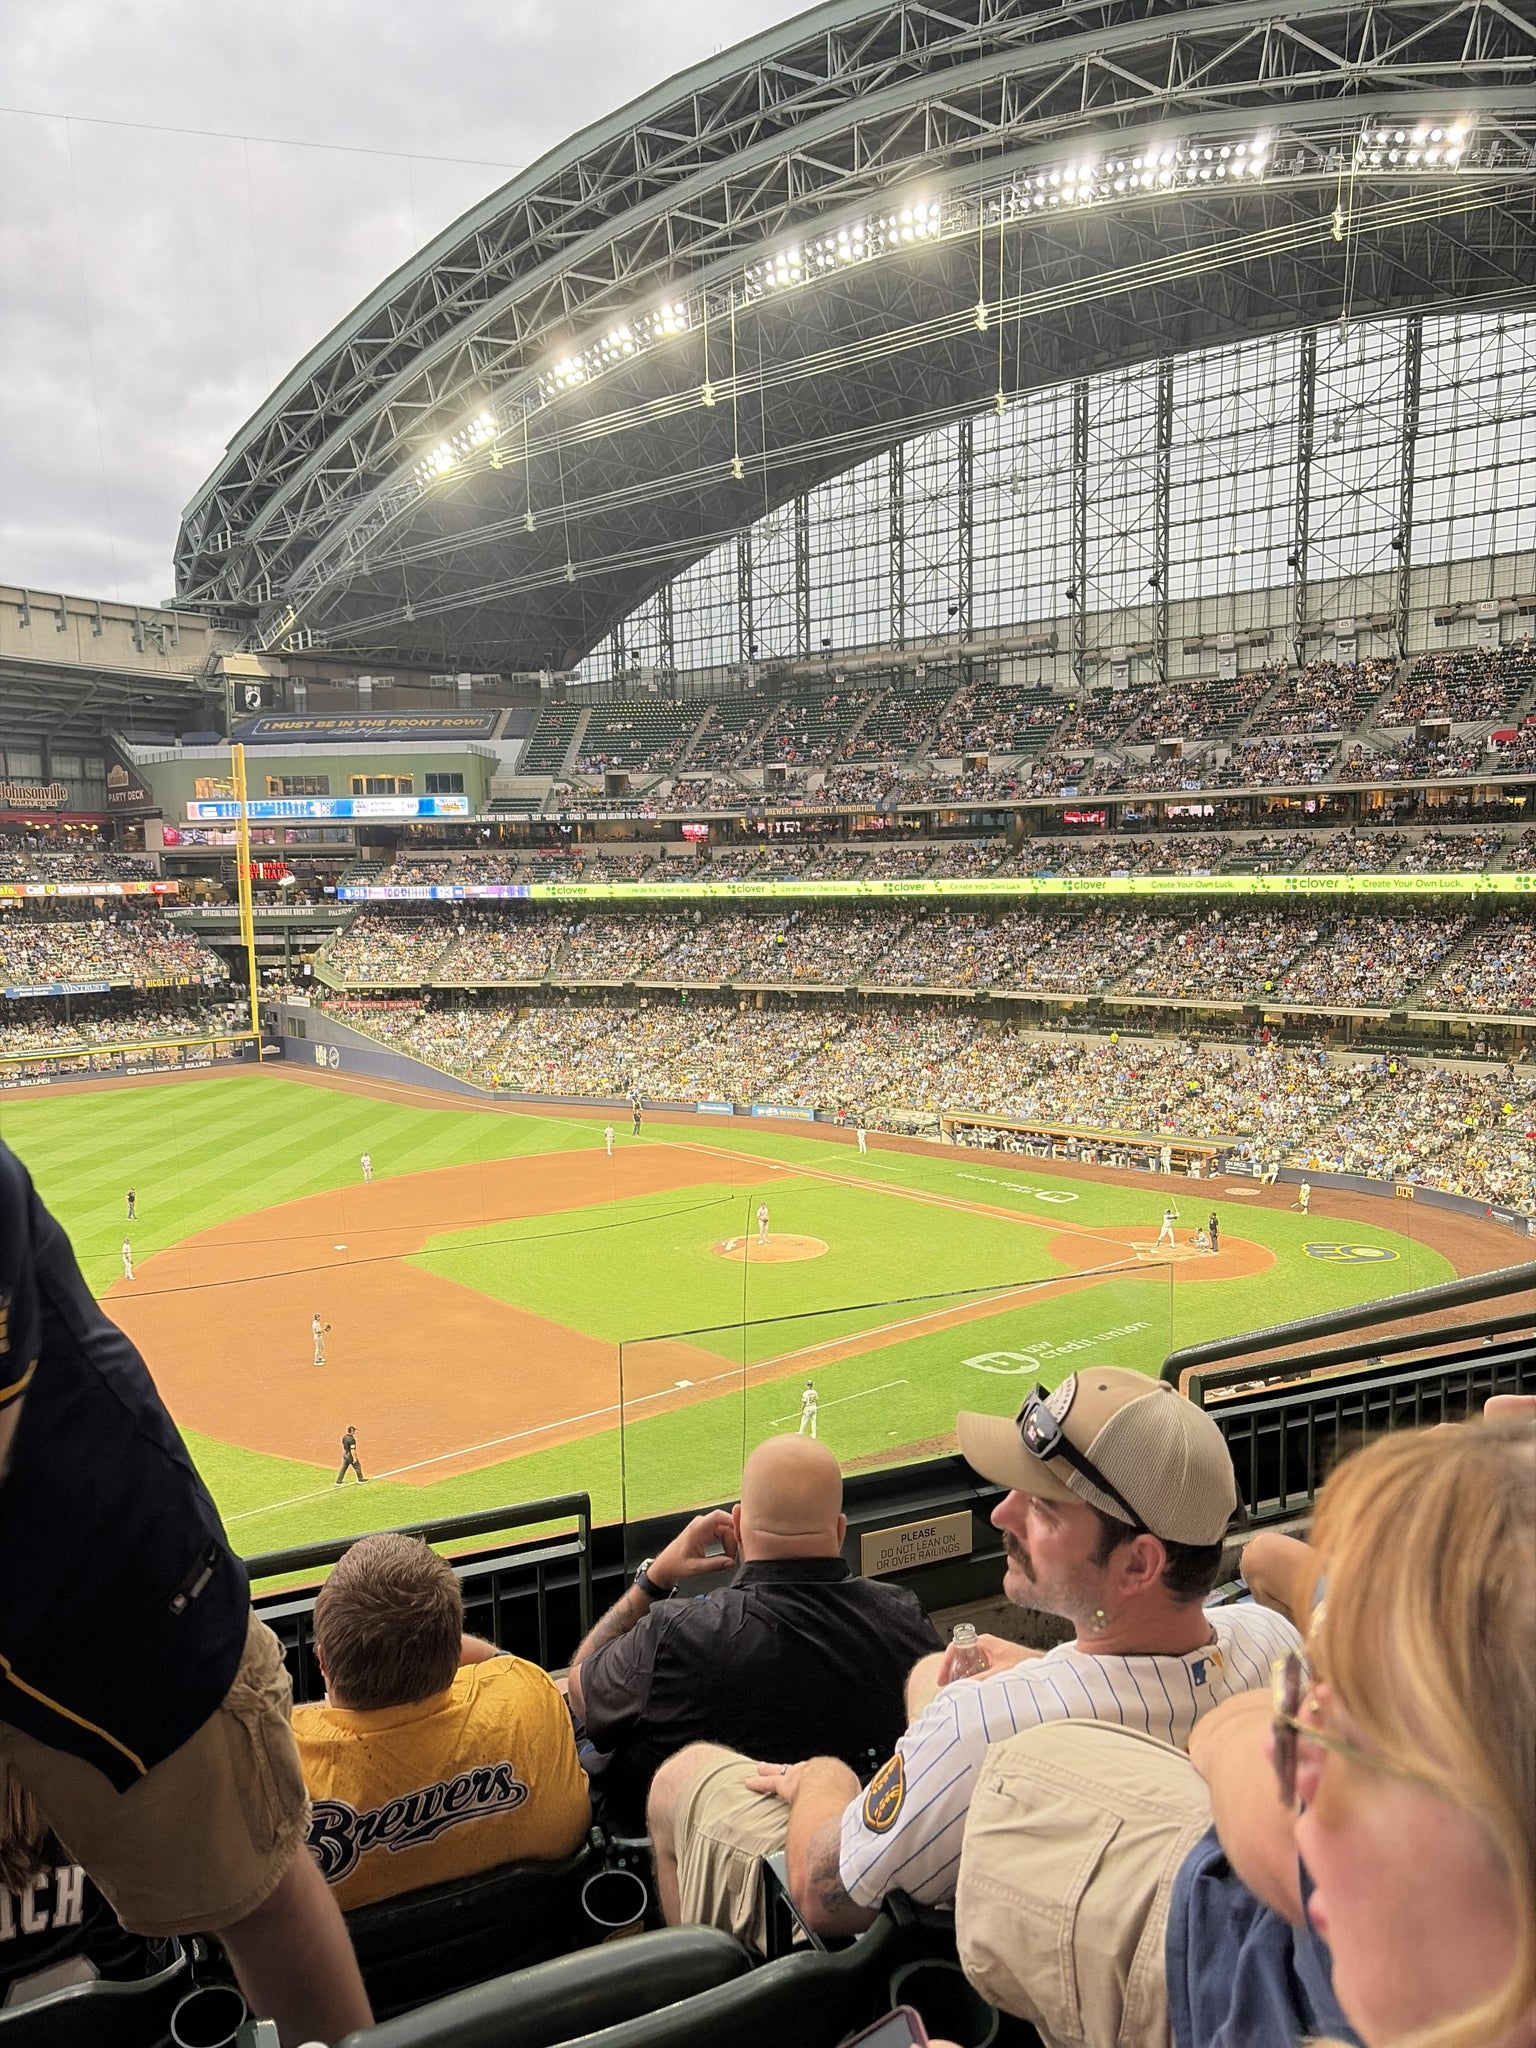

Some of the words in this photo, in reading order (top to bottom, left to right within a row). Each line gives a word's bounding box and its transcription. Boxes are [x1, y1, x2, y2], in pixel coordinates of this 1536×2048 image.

[272, 720, 314, 730] MUST
[316, 720, 335, 728] BE
[338, 719, 355, 728] IN
[358, 719, 386, 727] THE
[389, 718, 440, 726] FRONT
[442, 718, 484, 726] ROW!
[1, 784, 67, 800] Johnsonville
[108, 792, 126, 802] PARTY
[128, 790, 144, 801] DECK
[764, 808, 792, 816] BREWERS
[795, 806, 833, 814] COMMUNITY
[836, 804, 876, 813] FOUNDATION
[58, 884, 88, 894] before
[89, 886, 106, 895] you
[737, 884, 764, 894] clover
[894, 882, 926, 892] clover
[1074, 880, 1106, 890] clover
[1300, 878, 1339, 889] clover
[1362, 880, 1390, 888] Create
[1394, 880, 1418, 888] Your
[1421, 880, 1438, 888] Own
[1440, 880, 1464, 888] Luck.
[556, 886, 588, 895] clover
[62, 984, 106, 992] WINTRUST
[146, 978, 173, 988] NICOLET
[175, 976, 190, 986] LAW
[184, 1061, 210, 1069] BULLPEN
[20, 1078, 50, 1086] BULLPEN
[1040, 1338, 1098, 1359] credit
[1094, 1321, 1152, 1341] union
[1021, 1340, 1052, 1354] uw
[901, 1527, 936, 1543] PLEASE
[881, 1548, 894, 1560] DO
[896, 1543, 914, 1556] NOT
[916, 1538, 940, 1551] LEAN
[942, 1534, 956, 1544] ON
[876, 1558, 890, 1570] OR
[892, 1554, 916, 1567] OVER
[919, 1542, 960, 1561] RAILINGS
[307, 1760, 528, 1884] Brewers
